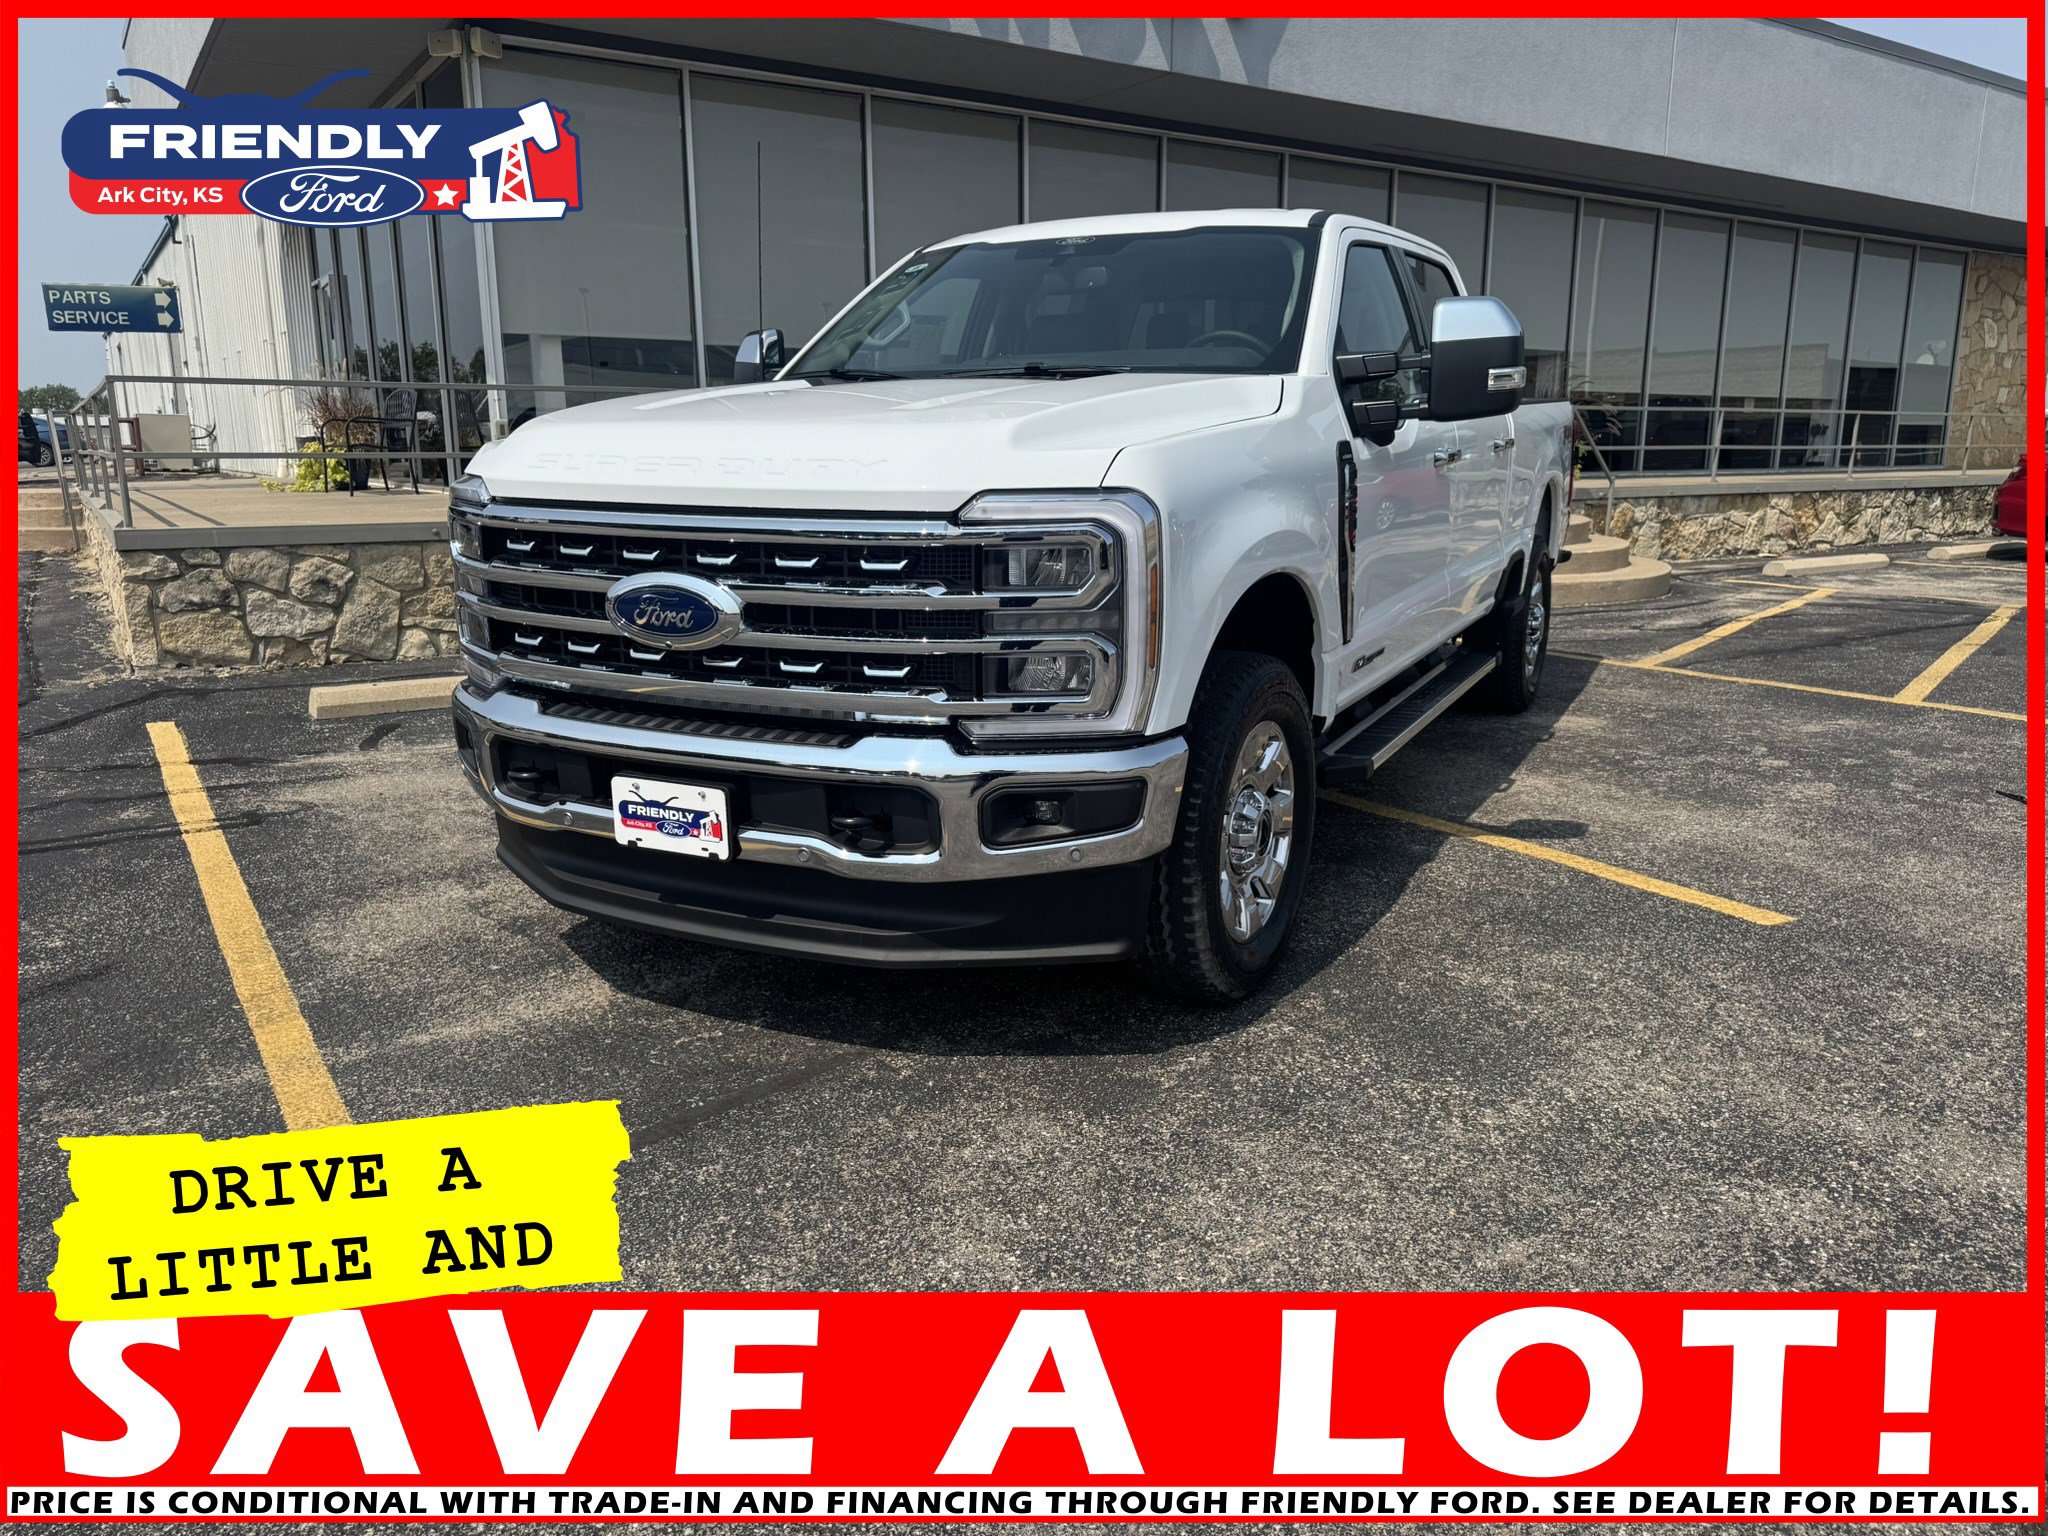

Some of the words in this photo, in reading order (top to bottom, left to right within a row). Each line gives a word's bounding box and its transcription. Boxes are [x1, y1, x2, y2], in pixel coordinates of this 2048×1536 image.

[48, 289, 111, 305] PARTS
[52, 310, 130, 325] SERVICE
[527, 453, 703, 475] SUPER
[716, 457, 888, 479] DUTY
[633, 593, 695, 629] Ford
[627, 804, 695, 823] FRIENDLY
[662, 822, 685, 836] Ford
